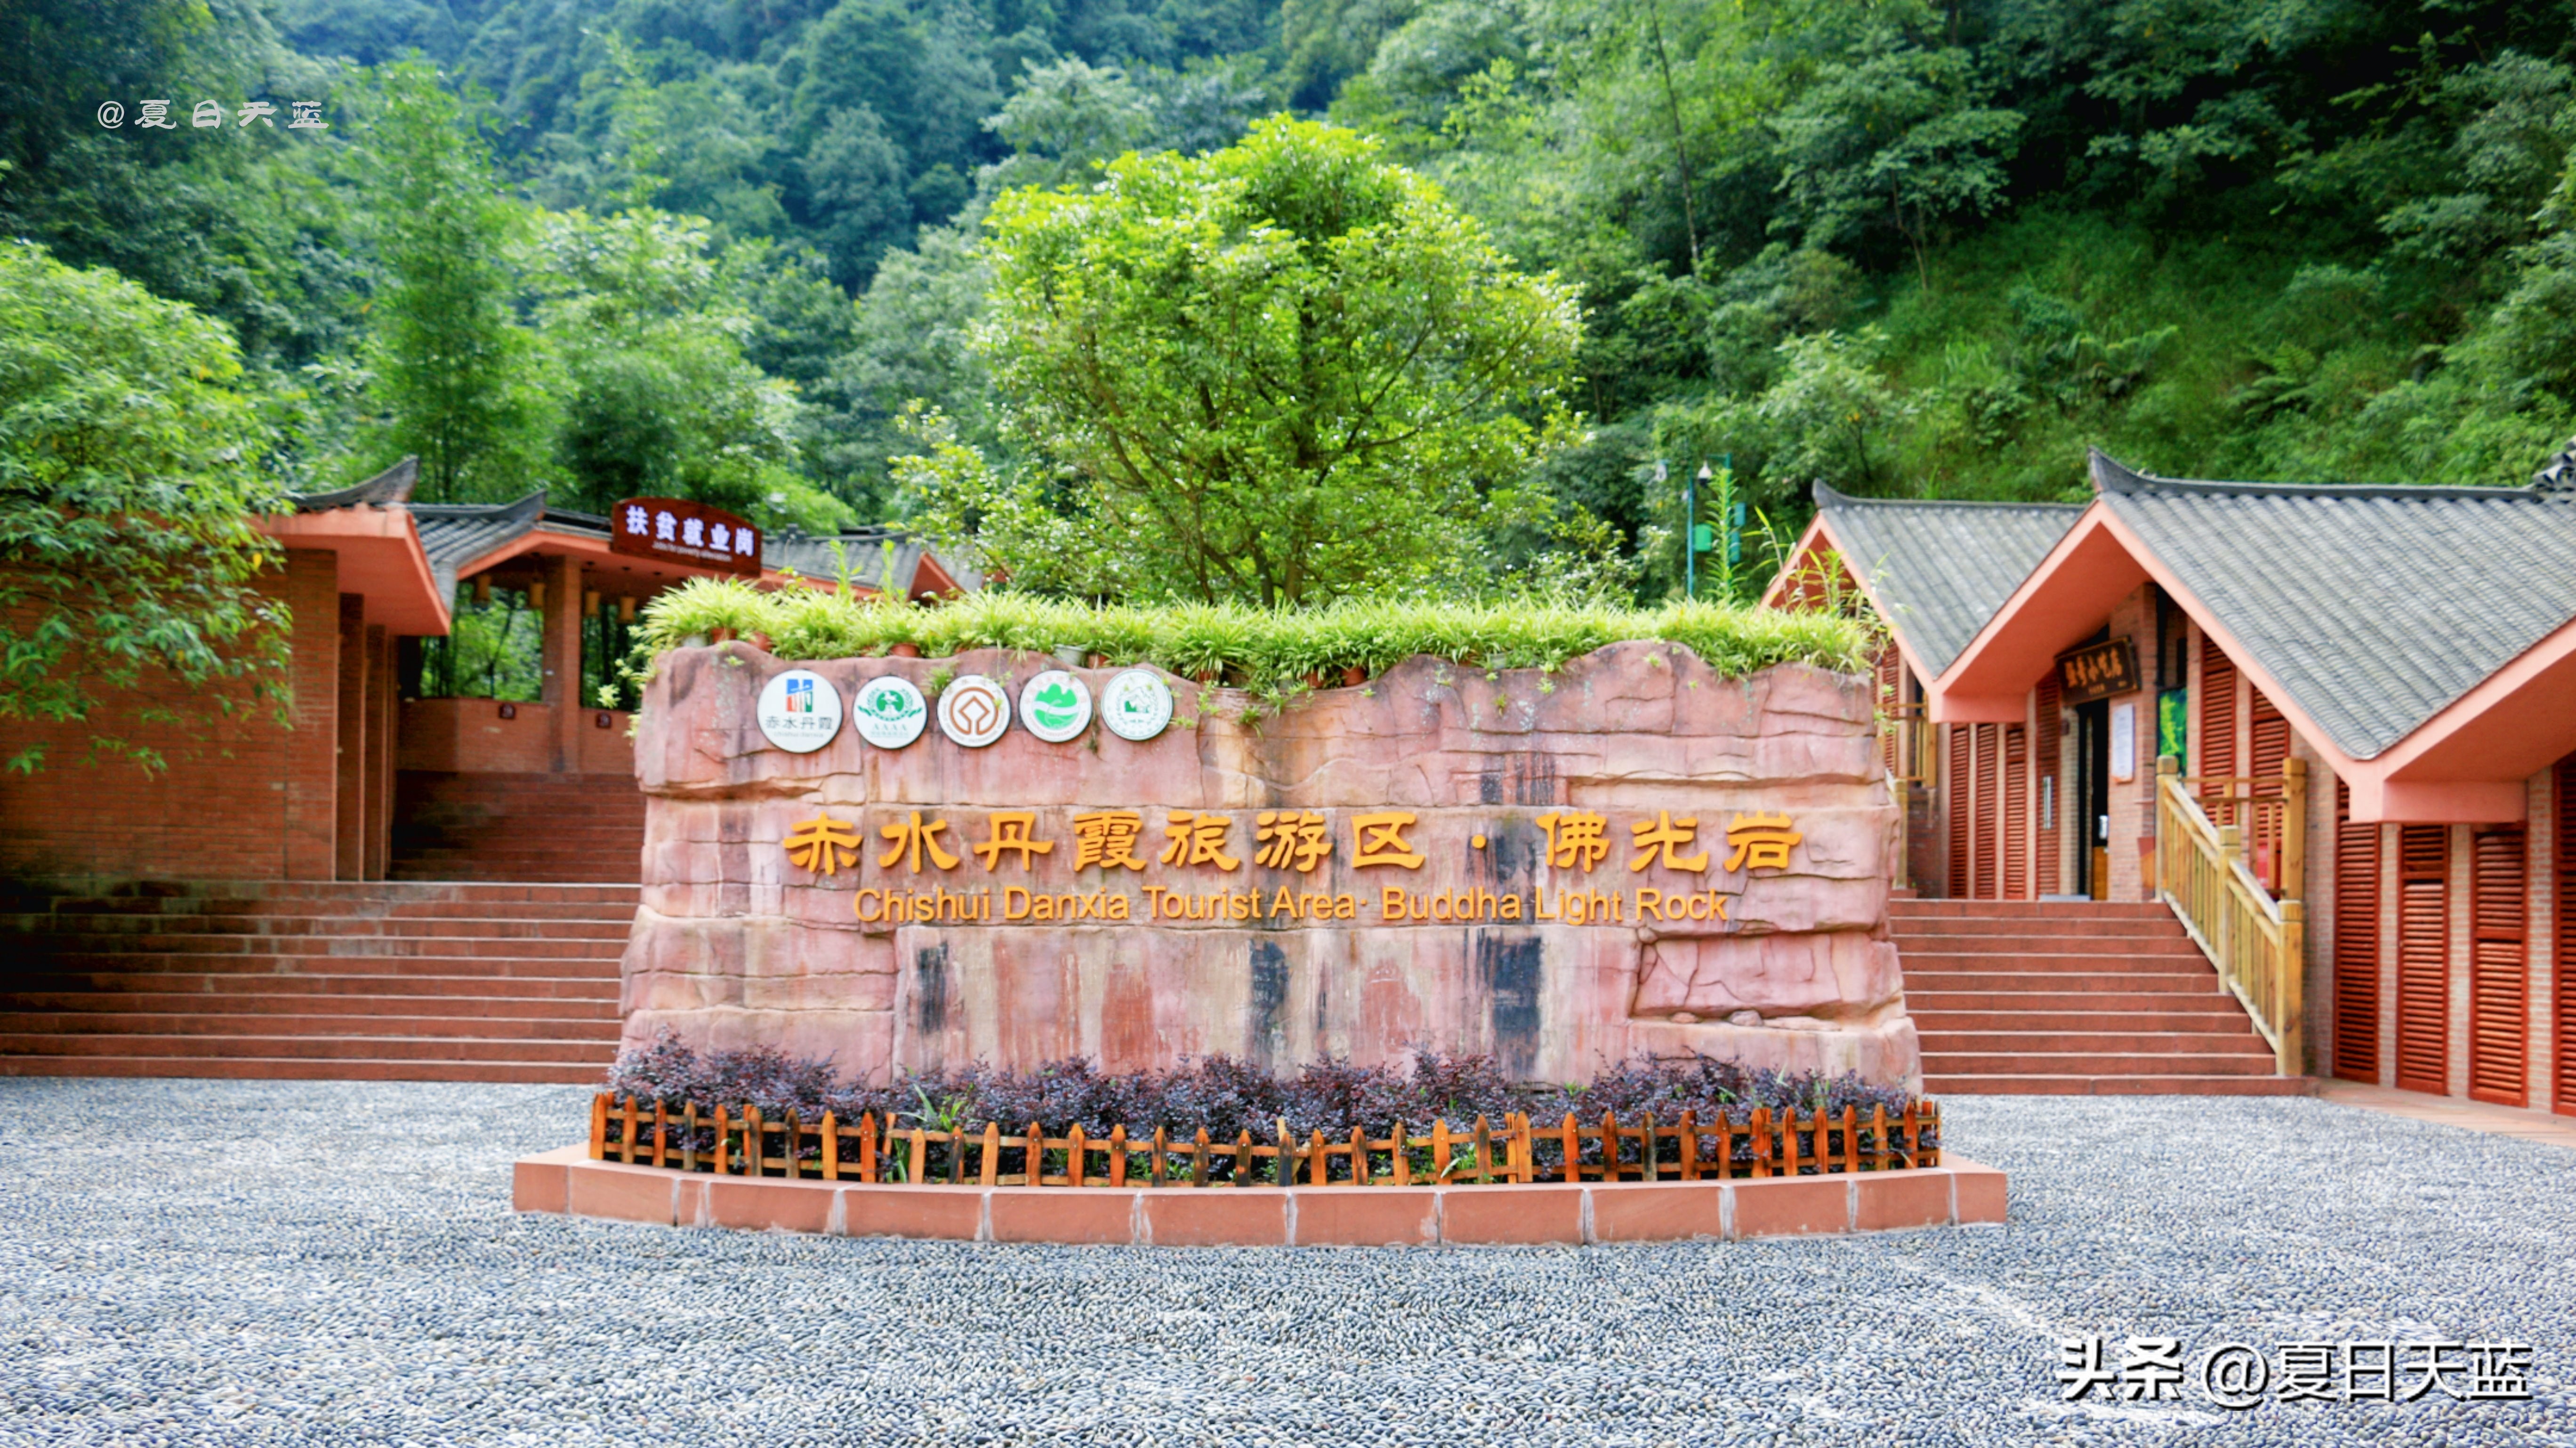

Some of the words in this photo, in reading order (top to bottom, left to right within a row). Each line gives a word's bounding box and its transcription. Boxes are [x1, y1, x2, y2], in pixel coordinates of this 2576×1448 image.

[626, 504, 755, 557] 扶贫就业岗
[765, 716, 832, 730] 赤水丹霞
[854, 888, 990, 922] Chishui
[1004, 886, 1130, 920] Danxia
[1142, 886, 1262, 919] Tourist
[1382, 887, 1521, 920] Buddha
[1536, 888, 1623, 926] Light
[1637, 888, 1728, 920] Rock
